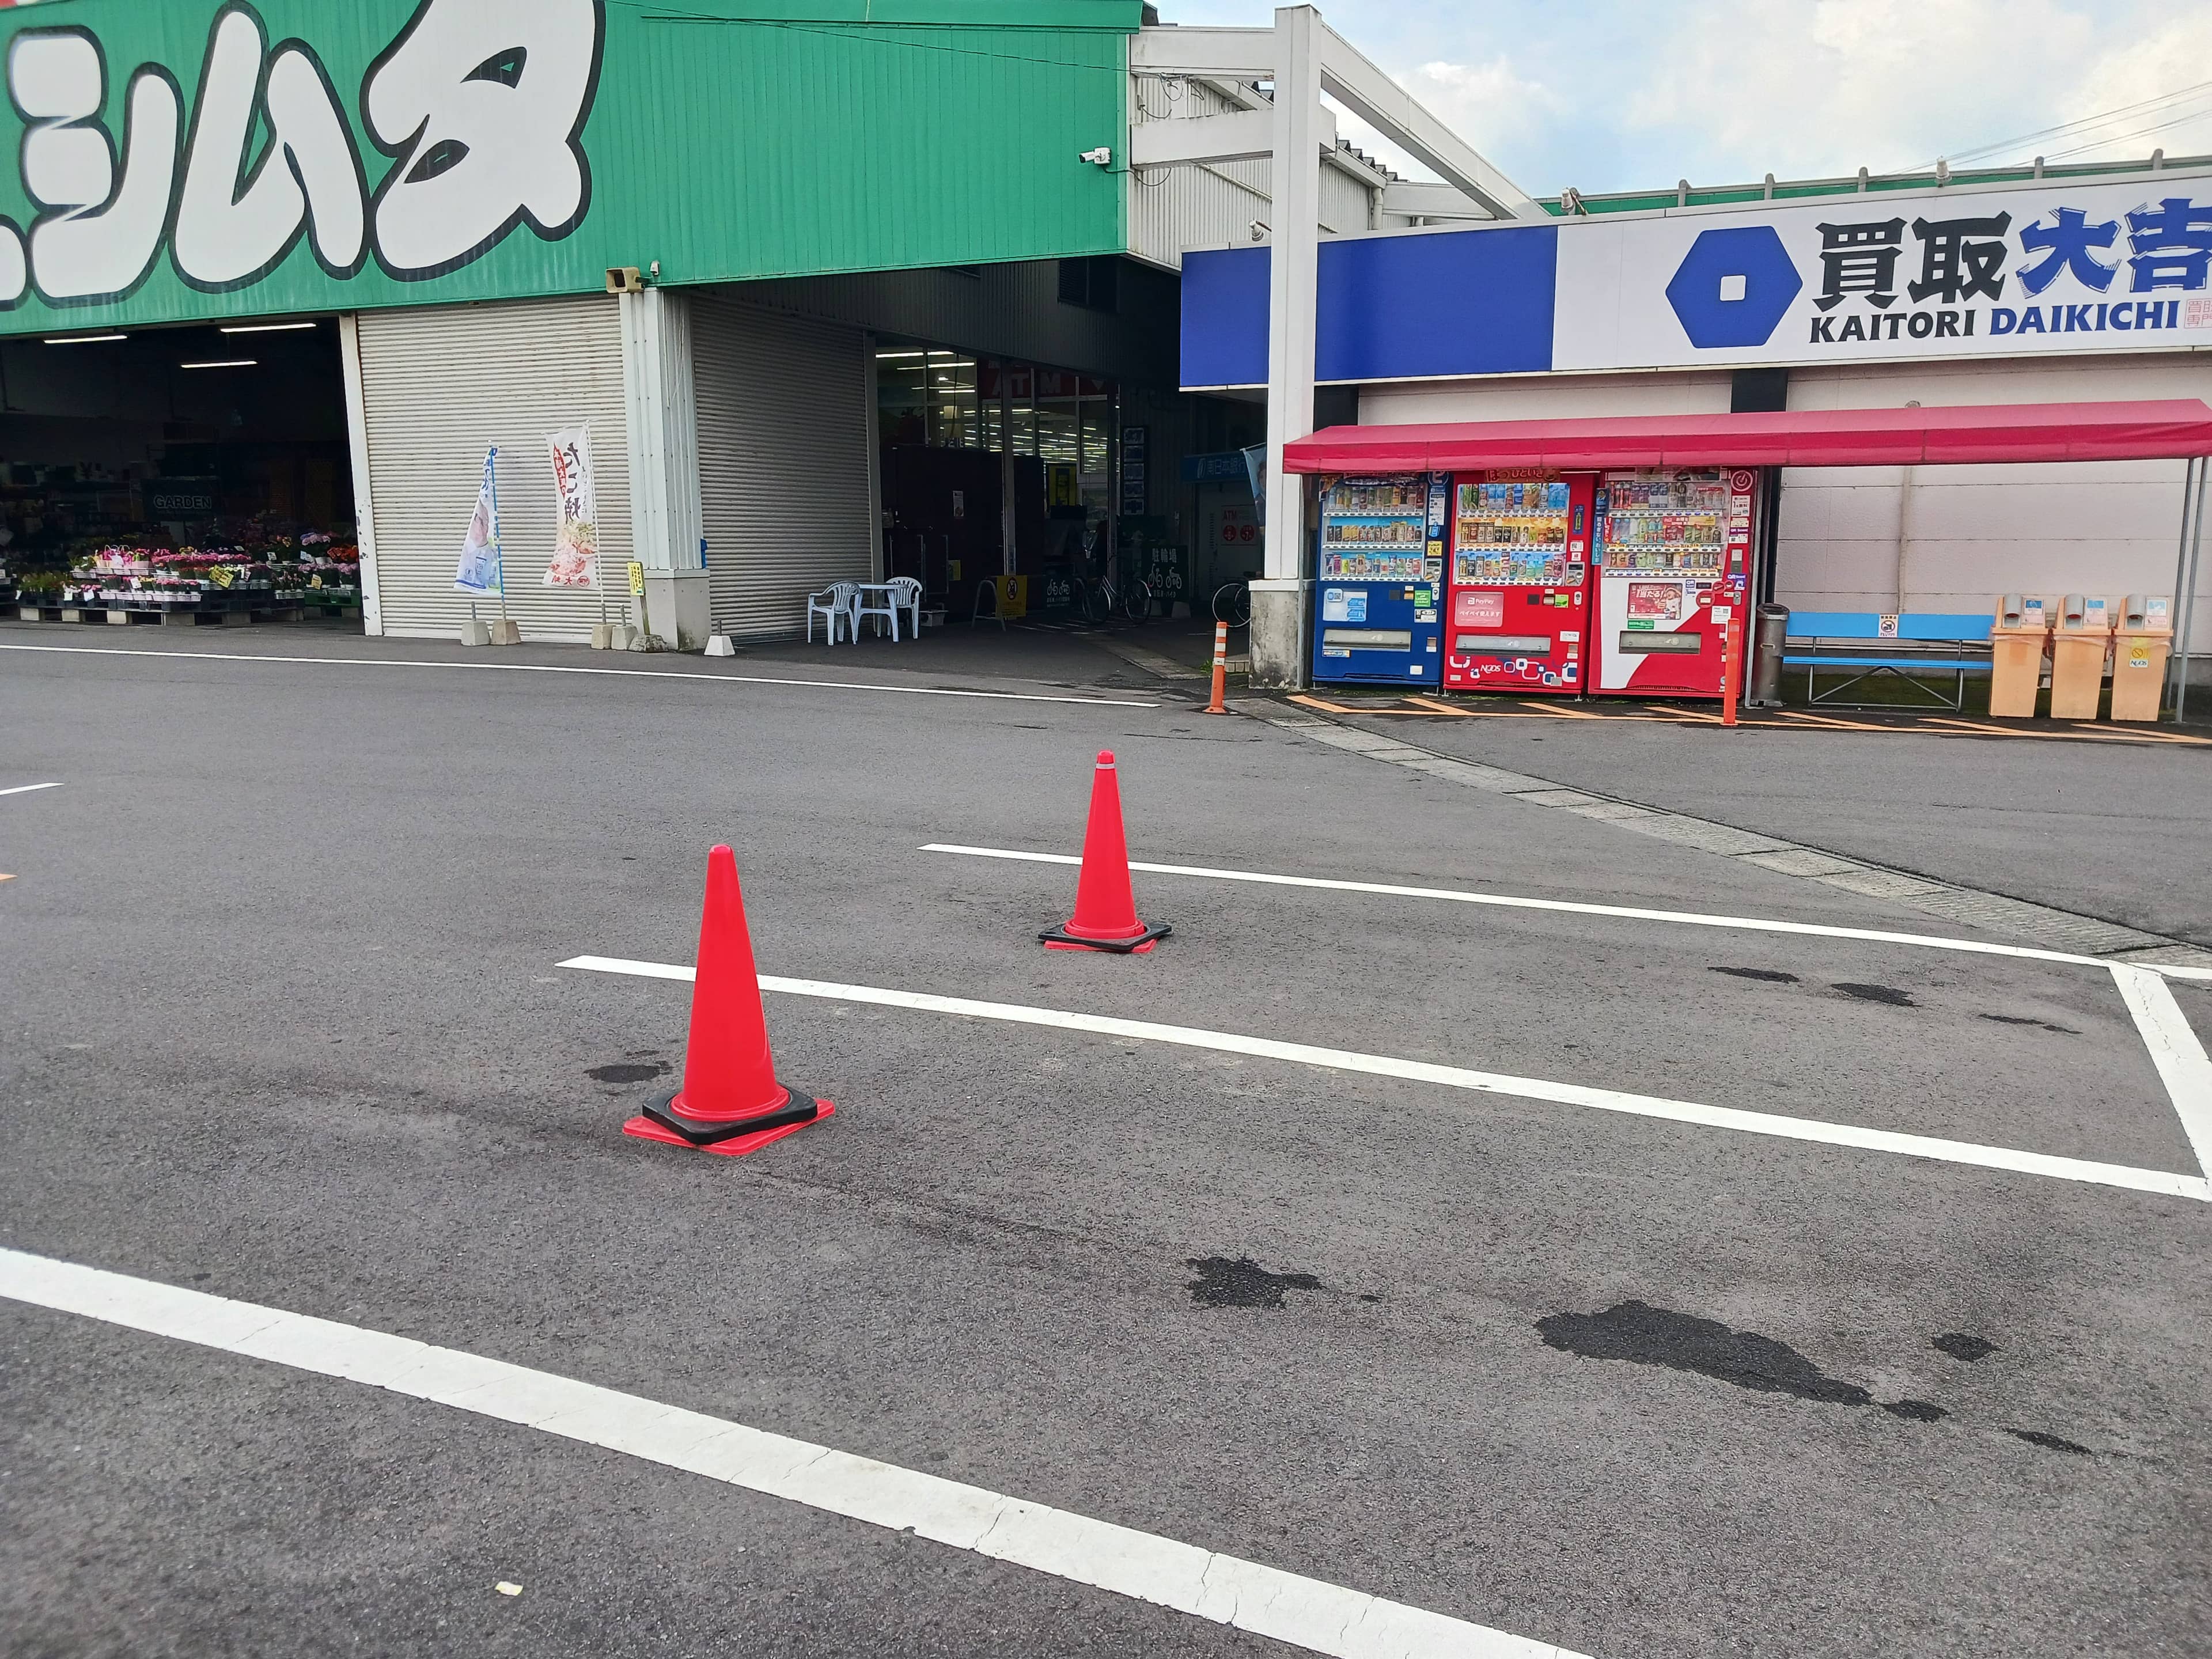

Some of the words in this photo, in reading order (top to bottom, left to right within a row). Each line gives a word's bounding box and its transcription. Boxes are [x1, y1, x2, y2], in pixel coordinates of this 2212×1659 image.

[0, 0, 605, 311] シムタ
[1809, 308, 1975, 344] KAITORI
[1990, 300, 2181, 337] DAIKICHI
[153, 494, 213, 509] GARDEN
[1152, 548, 1177, 563] 駐輪場
